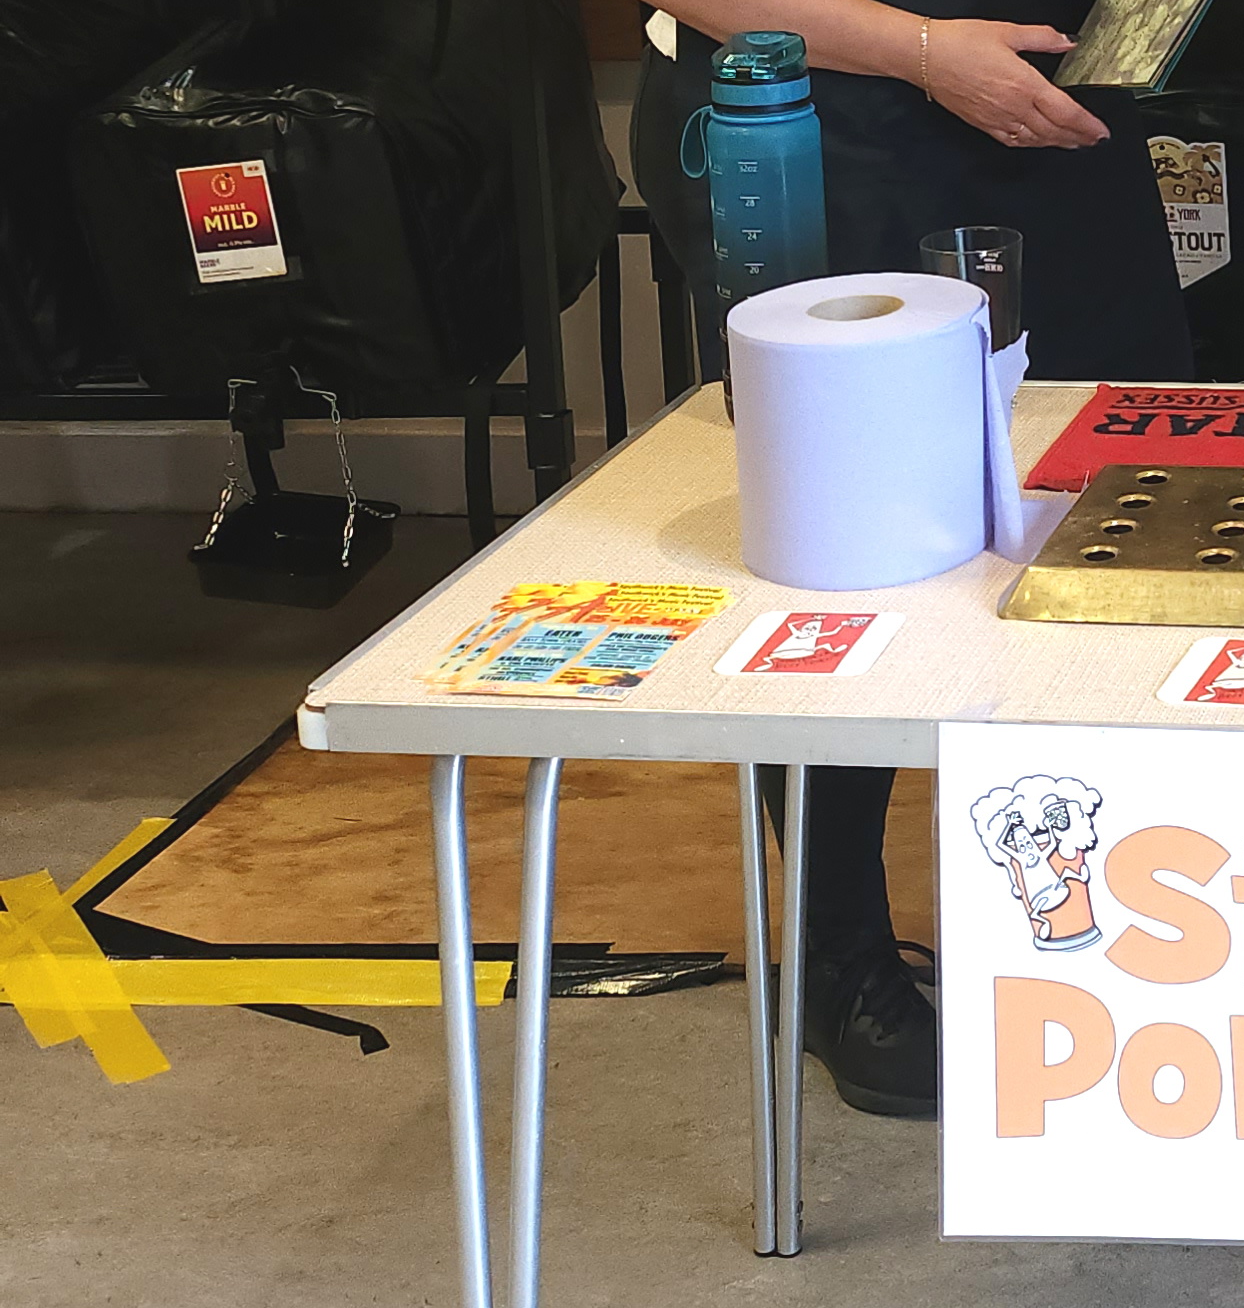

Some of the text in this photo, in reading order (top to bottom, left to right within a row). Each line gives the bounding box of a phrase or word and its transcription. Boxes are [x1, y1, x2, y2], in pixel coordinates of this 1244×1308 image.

[209, 202, 246, 213] MARBLE
[202, 211, 259, 234] MILD
[1170, 231, 1226, 252] TOUT
[1116, 393, 1244, 407] SUSSEX
